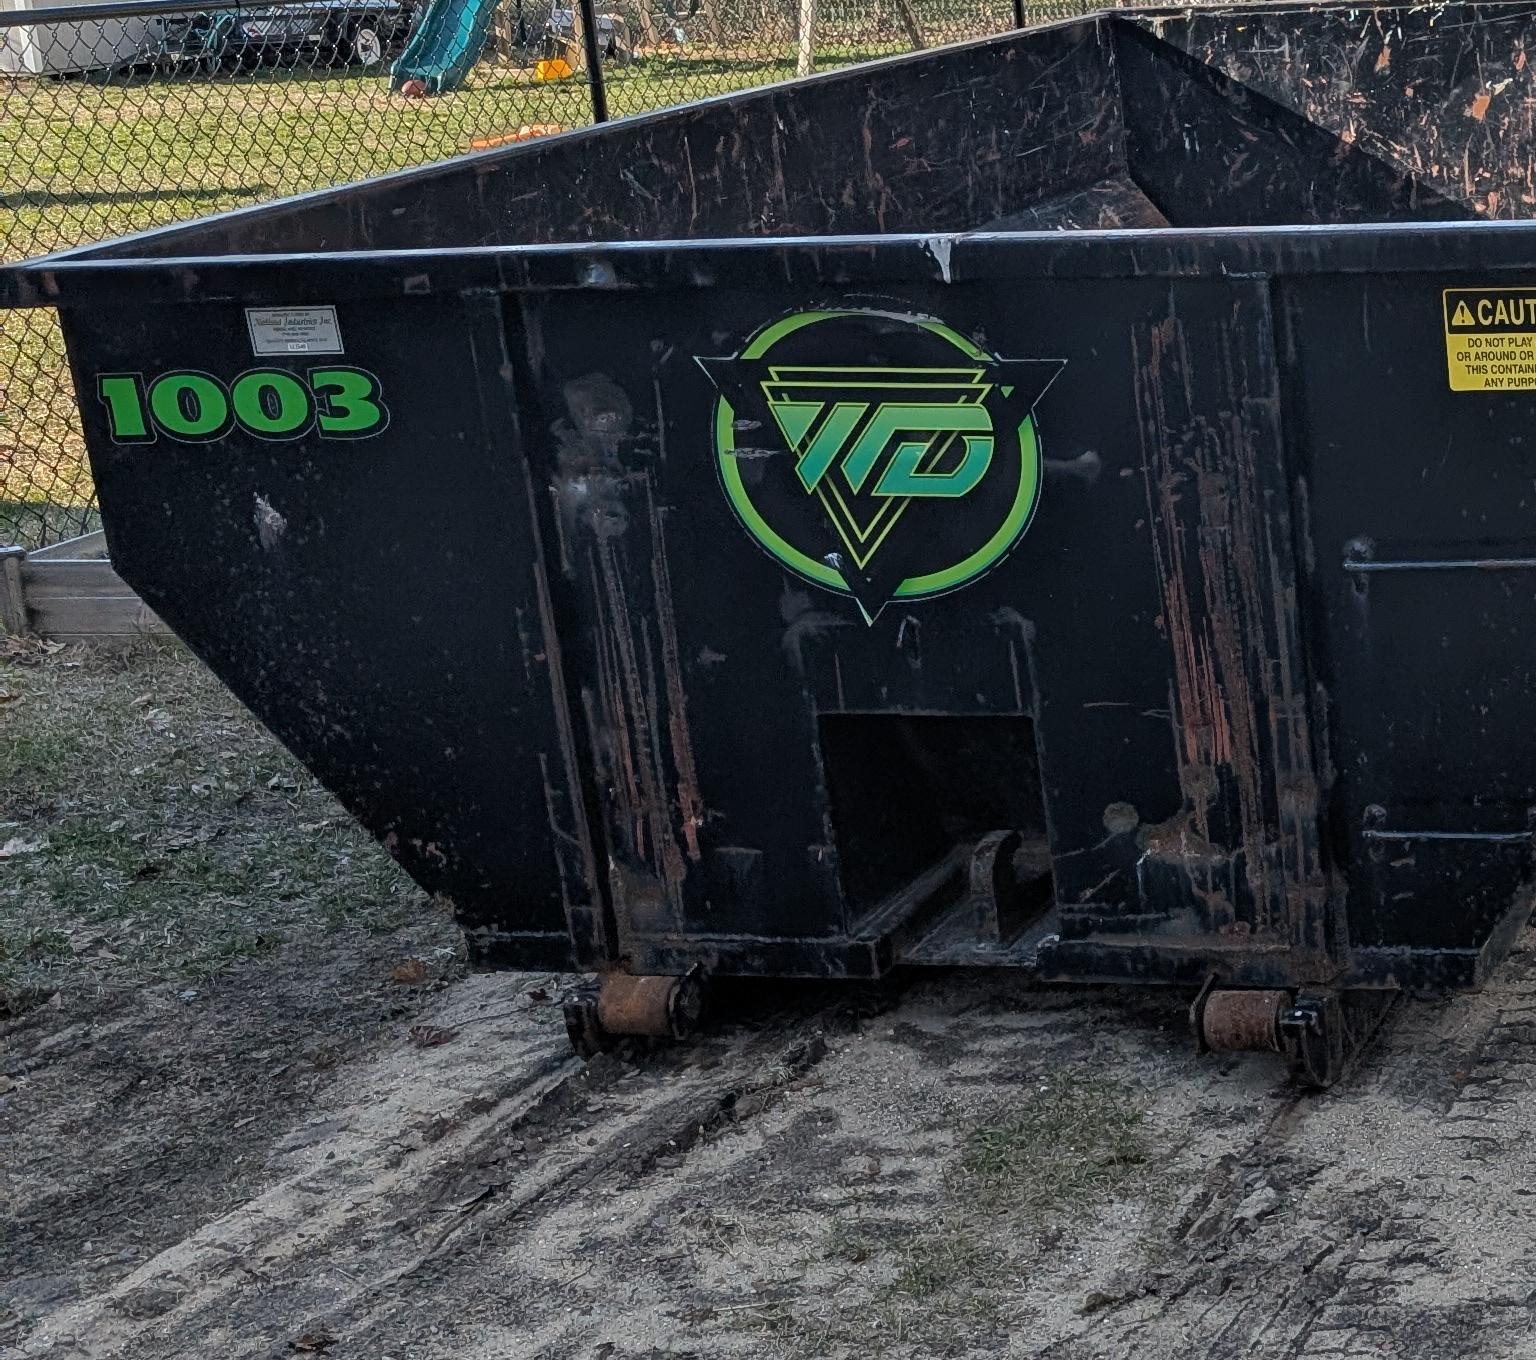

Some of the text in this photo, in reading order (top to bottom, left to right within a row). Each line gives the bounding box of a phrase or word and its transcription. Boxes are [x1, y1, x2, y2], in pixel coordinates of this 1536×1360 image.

[1467, 338, 1482, 348] DO
[1485, 337, 1505, 348] NOT
[1508, 337, 1533, 348] PLAY
[1456, 351, 1471, 362] OR
[1474, 351, 1516, 361] AROUND
[1519, 350, 1534, 361] OR
[1465, 365, 1488, 375] THIS
[1484, 378, 1504, 387] ANY
[101, 369, 382, 438] 1003
